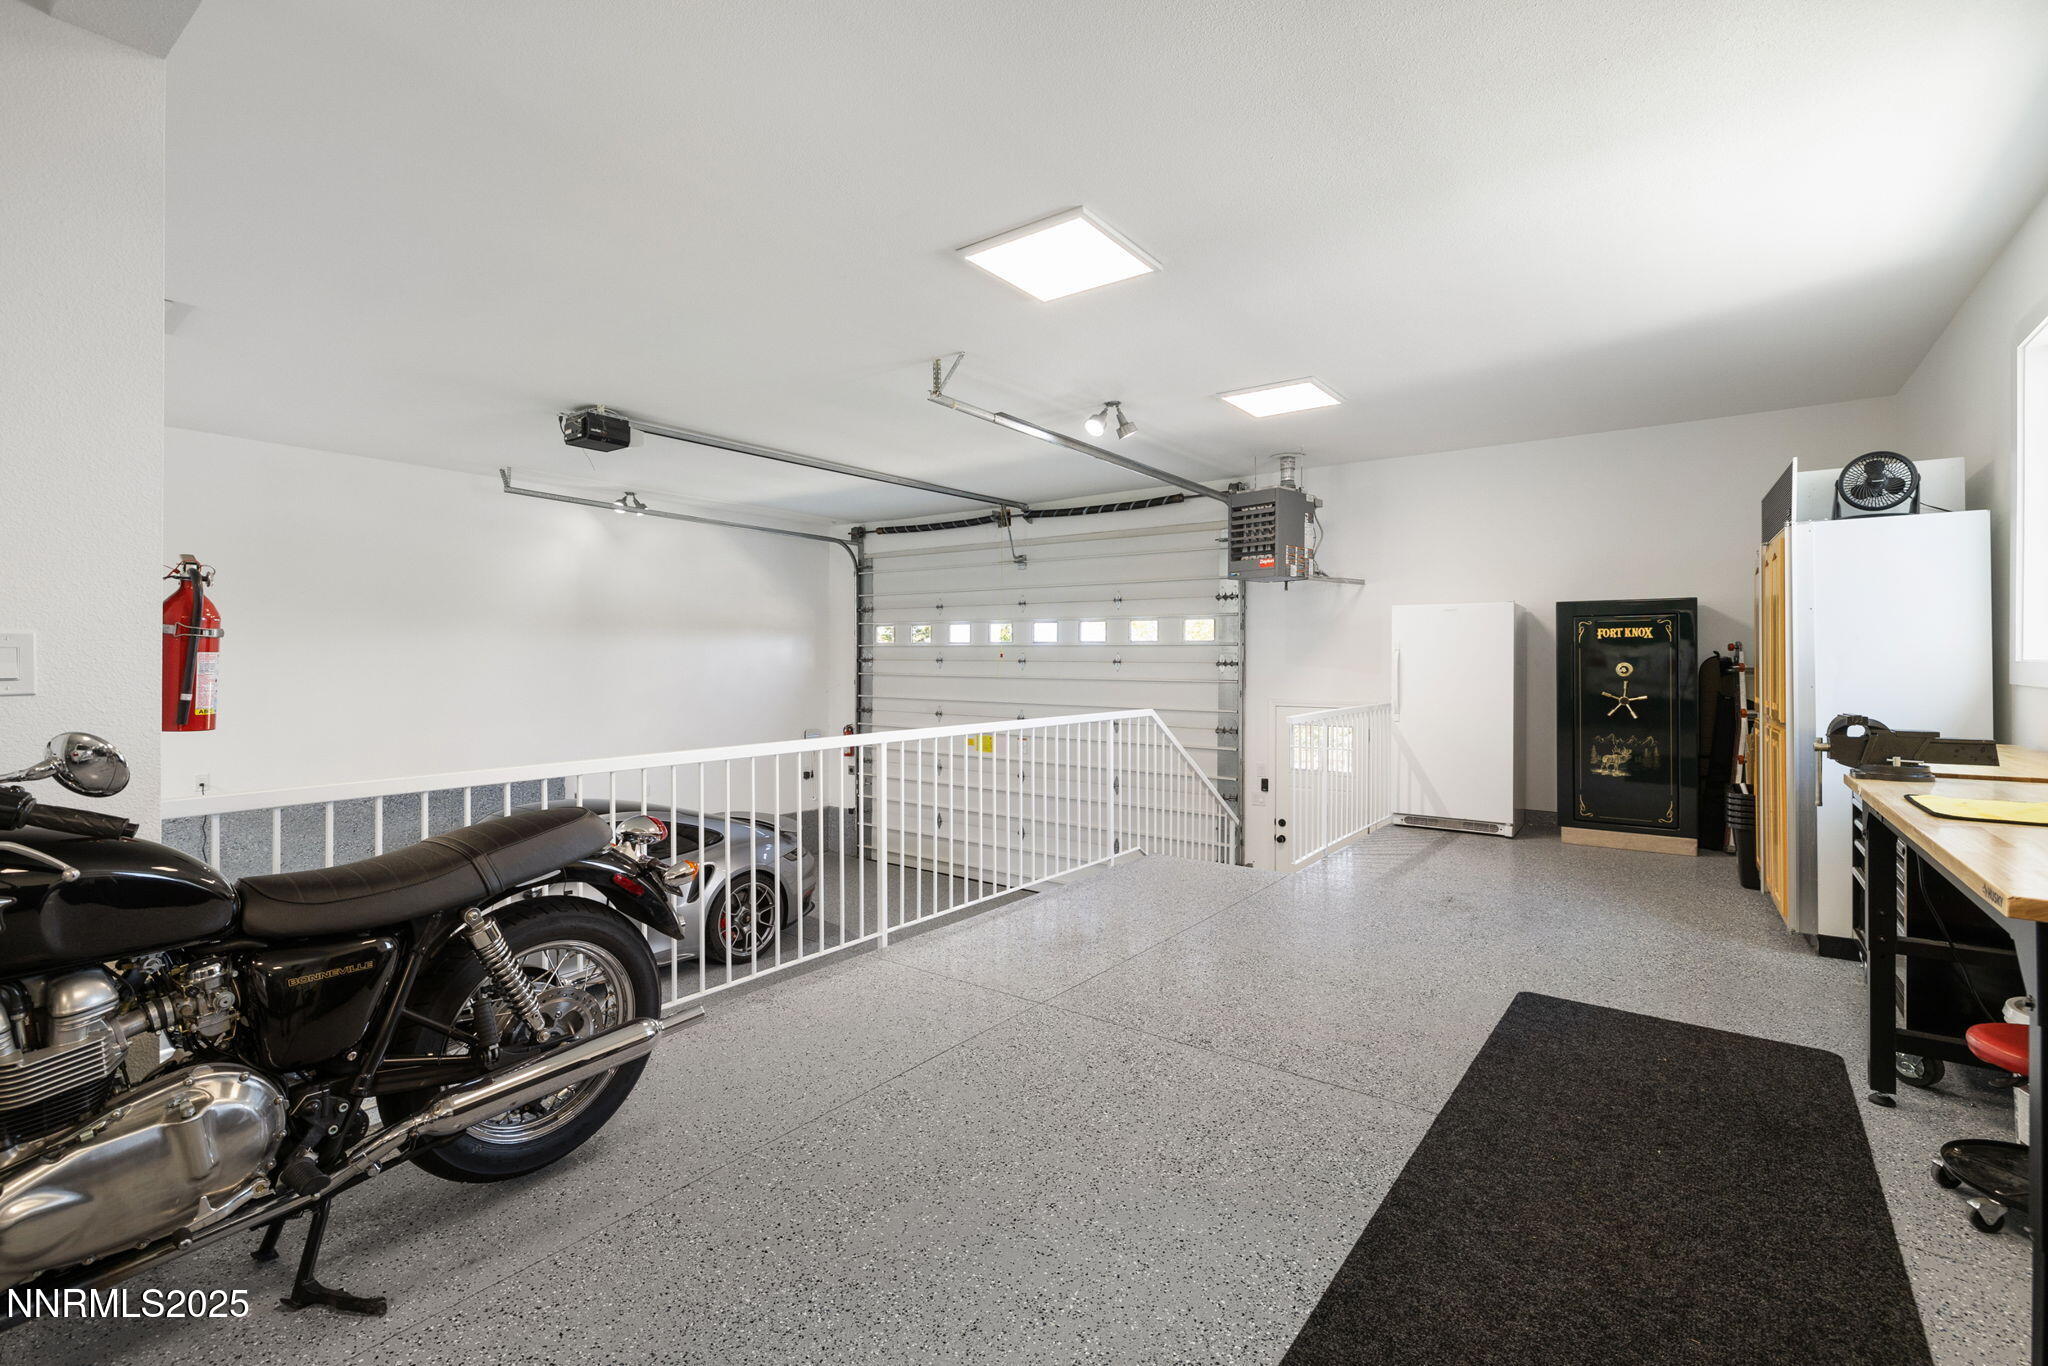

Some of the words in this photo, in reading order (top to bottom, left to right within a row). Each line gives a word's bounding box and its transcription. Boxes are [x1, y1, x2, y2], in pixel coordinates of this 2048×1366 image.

[1597, 628, 1624, 639] FORT
[1624, 627, 1654, 639] KNOX
[1987, 887, 2003, 908] HUSKY
[287, 960, 374, 987] BONNEVILLE
